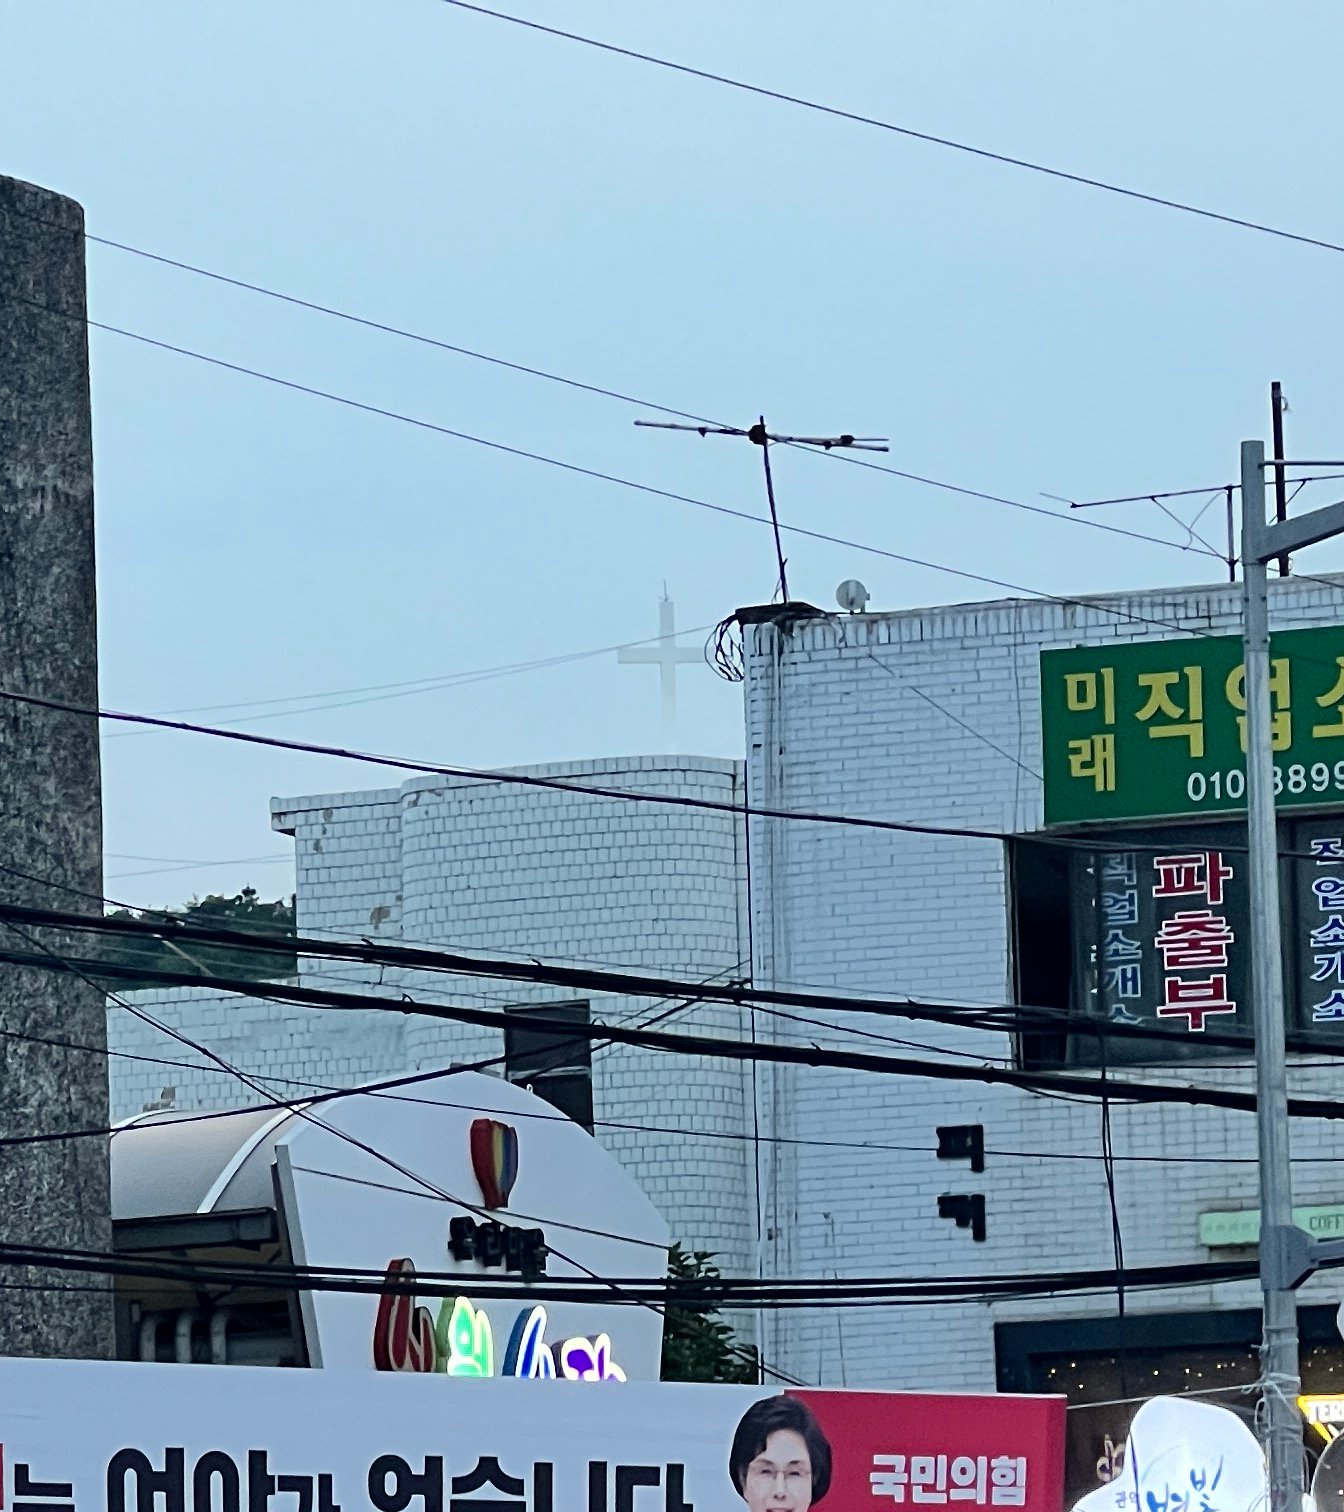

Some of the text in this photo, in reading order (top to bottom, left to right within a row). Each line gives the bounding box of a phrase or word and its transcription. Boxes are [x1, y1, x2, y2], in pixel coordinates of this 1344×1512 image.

[1064, 667, 1116, 792] 미래
[1153, 851, 1236, 1032] 파출부
[869, 1454, 1027, 1506] 국민의힘
